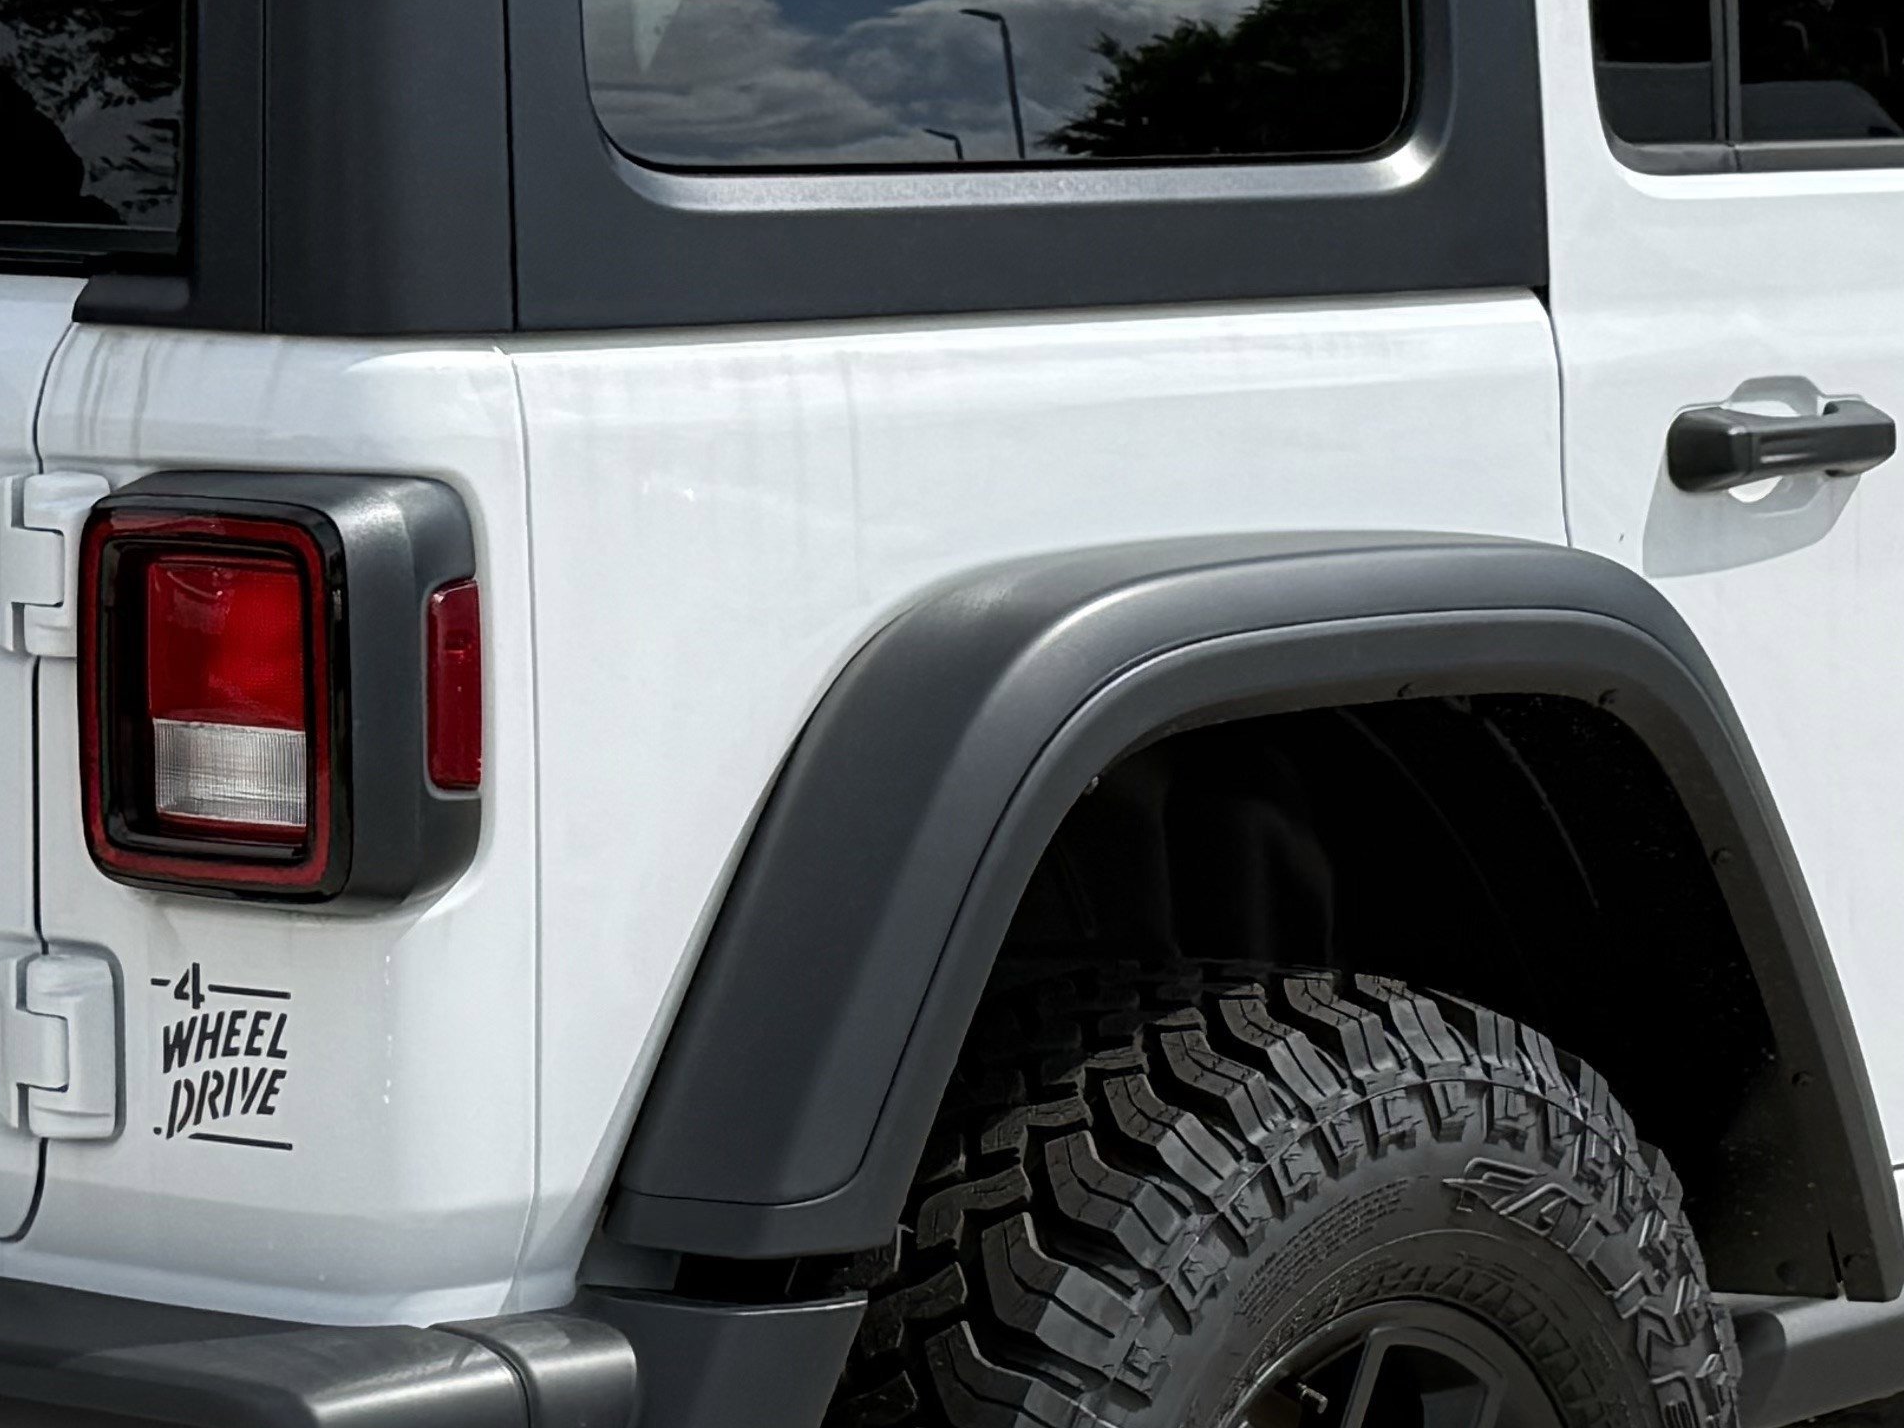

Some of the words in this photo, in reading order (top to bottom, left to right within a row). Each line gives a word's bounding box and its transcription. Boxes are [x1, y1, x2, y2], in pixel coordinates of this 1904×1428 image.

[174, 962, 205, 1010] 4
[162, 1010, 288, 1074] WHEEL
[166, 1066, 288, 1140] DRIVE
